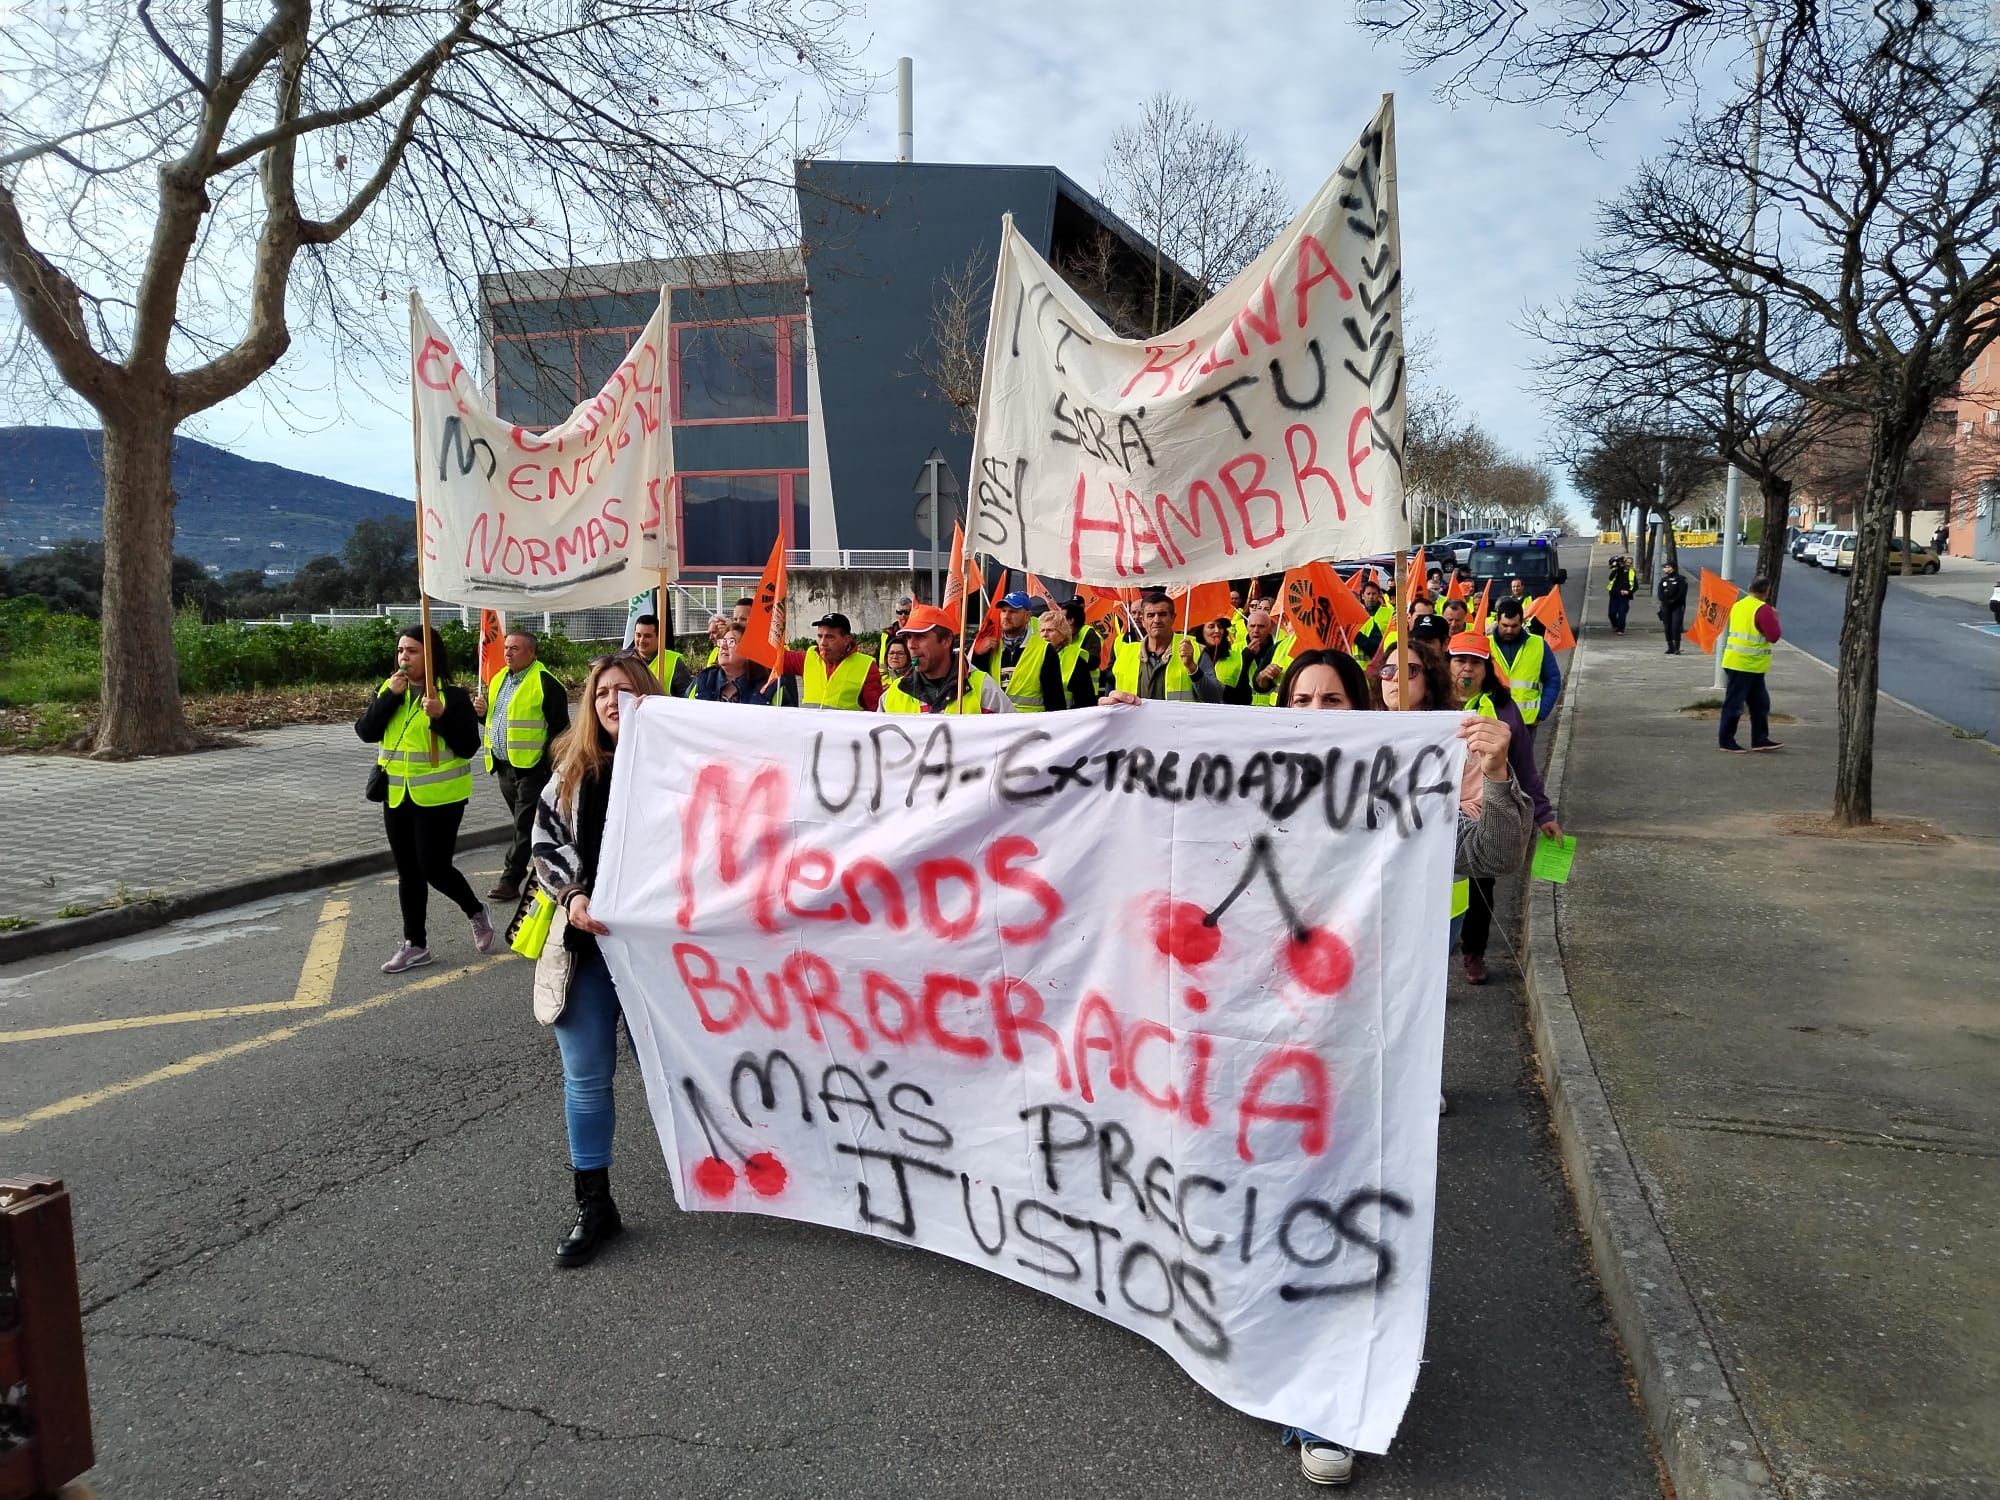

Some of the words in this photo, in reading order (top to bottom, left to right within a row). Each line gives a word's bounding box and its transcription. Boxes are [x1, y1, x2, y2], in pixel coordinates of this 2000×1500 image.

[1192, 338, 1327, 439] TU
[465, 498, 629, 576] NORMAS
[978, 456, 1012, 546] UPA
[1070, 406, 1374, 579] HAMBRE
[836, 1142, 1231, 1362] JUSTOS
[1019, 1103, 1416, 1302] PRECIOS
